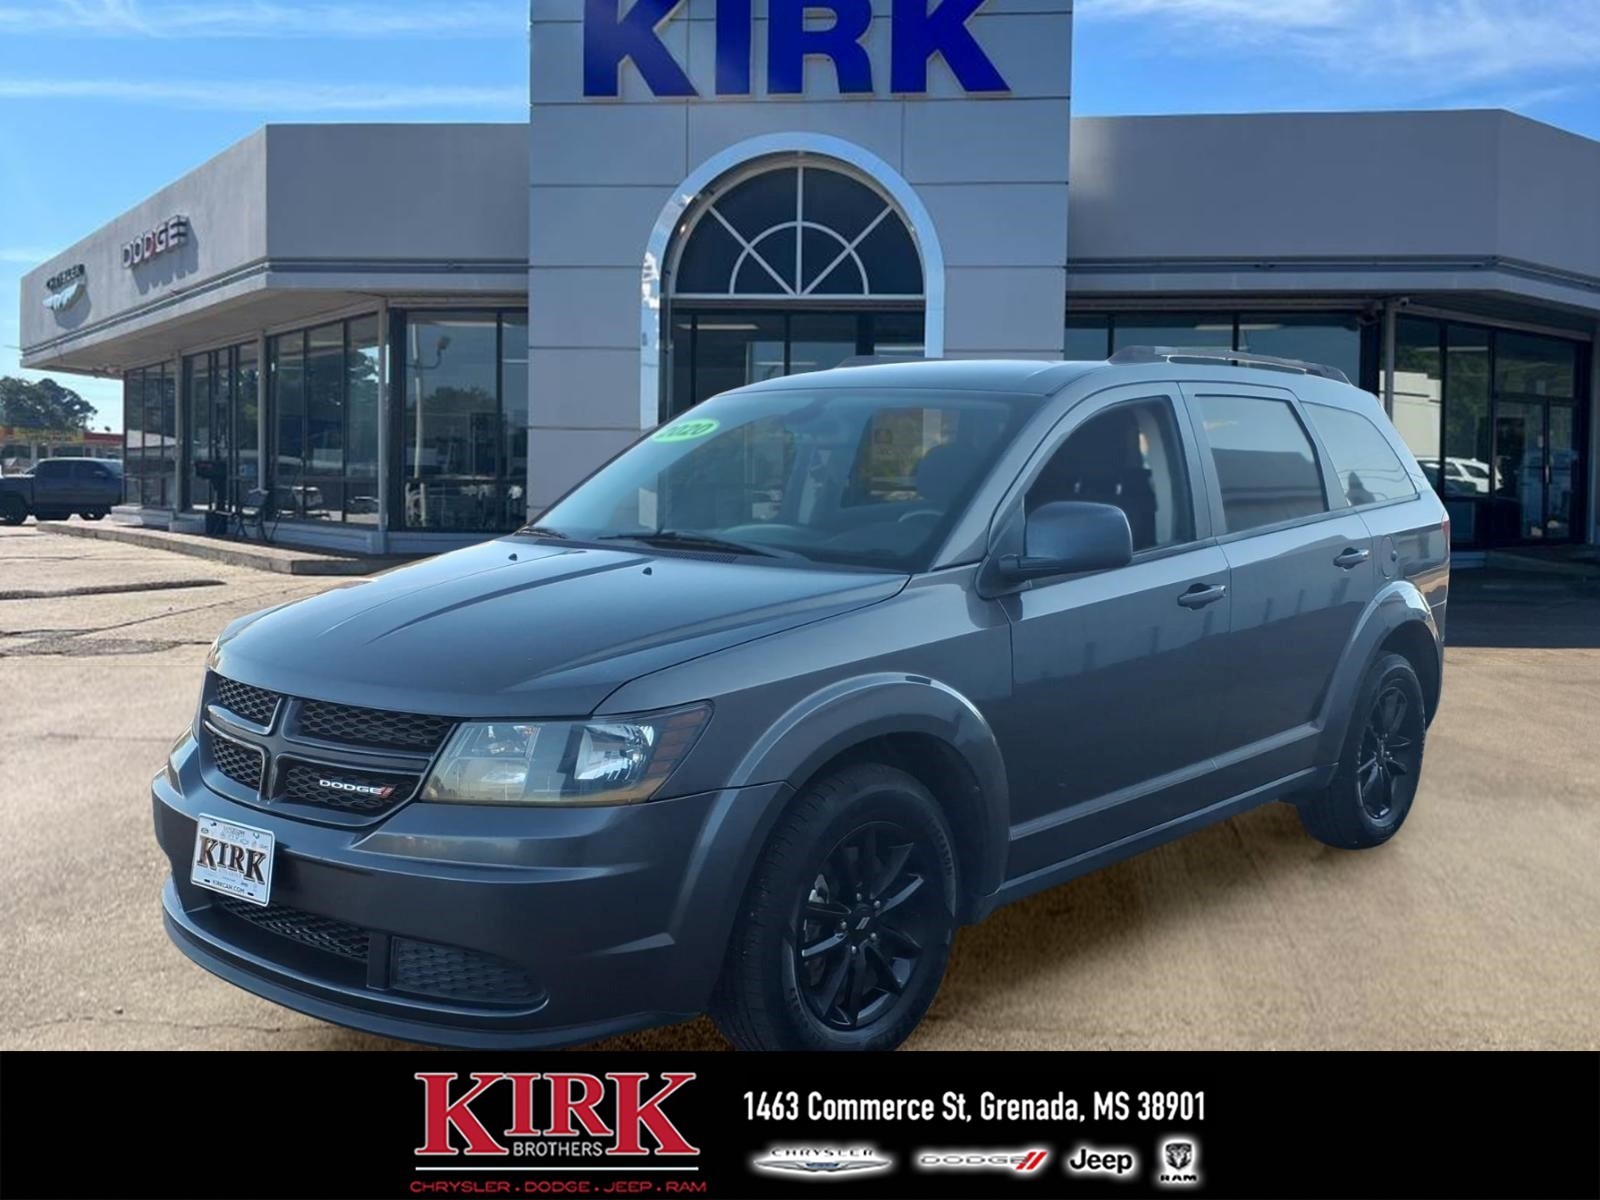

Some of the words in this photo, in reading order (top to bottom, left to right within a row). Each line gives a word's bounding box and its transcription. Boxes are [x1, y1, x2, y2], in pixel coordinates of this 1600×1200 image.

[583, 0, 1011, 98] KIRK
[121, 214, 190, 268] DODGE
[319, 779, 383, 795] DODGE
[197, 837, 267, 886] KIRK
